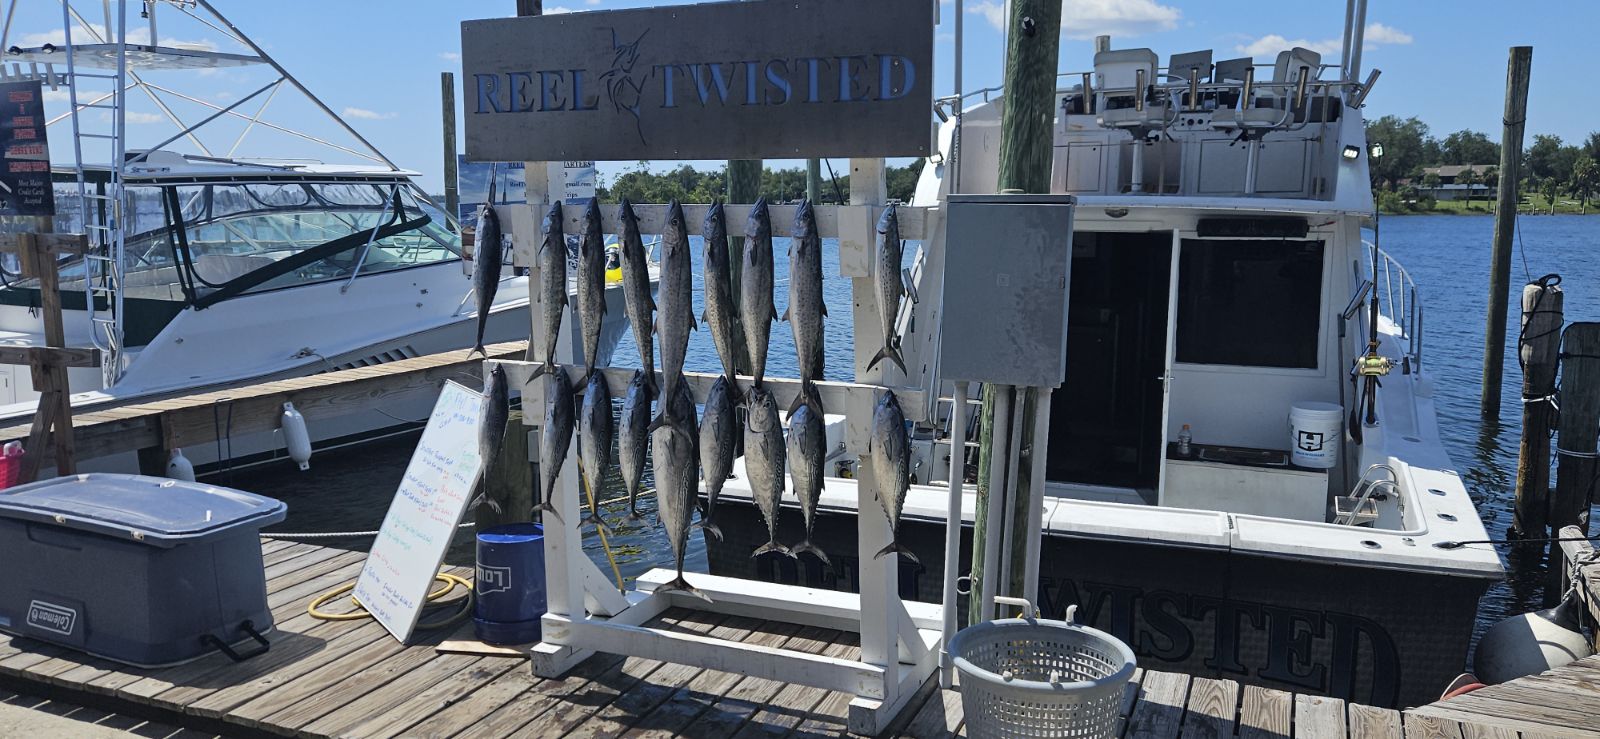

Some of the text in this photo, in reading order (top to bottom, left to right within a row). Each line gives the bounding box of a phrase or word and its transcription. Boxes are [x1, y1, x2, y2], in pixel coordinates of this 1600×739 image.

[473, 54, 917, 115] REEL TWISTED
[38, 610, 70, 631] Coleman
[1040, 576, 1401, 708] WISTED
